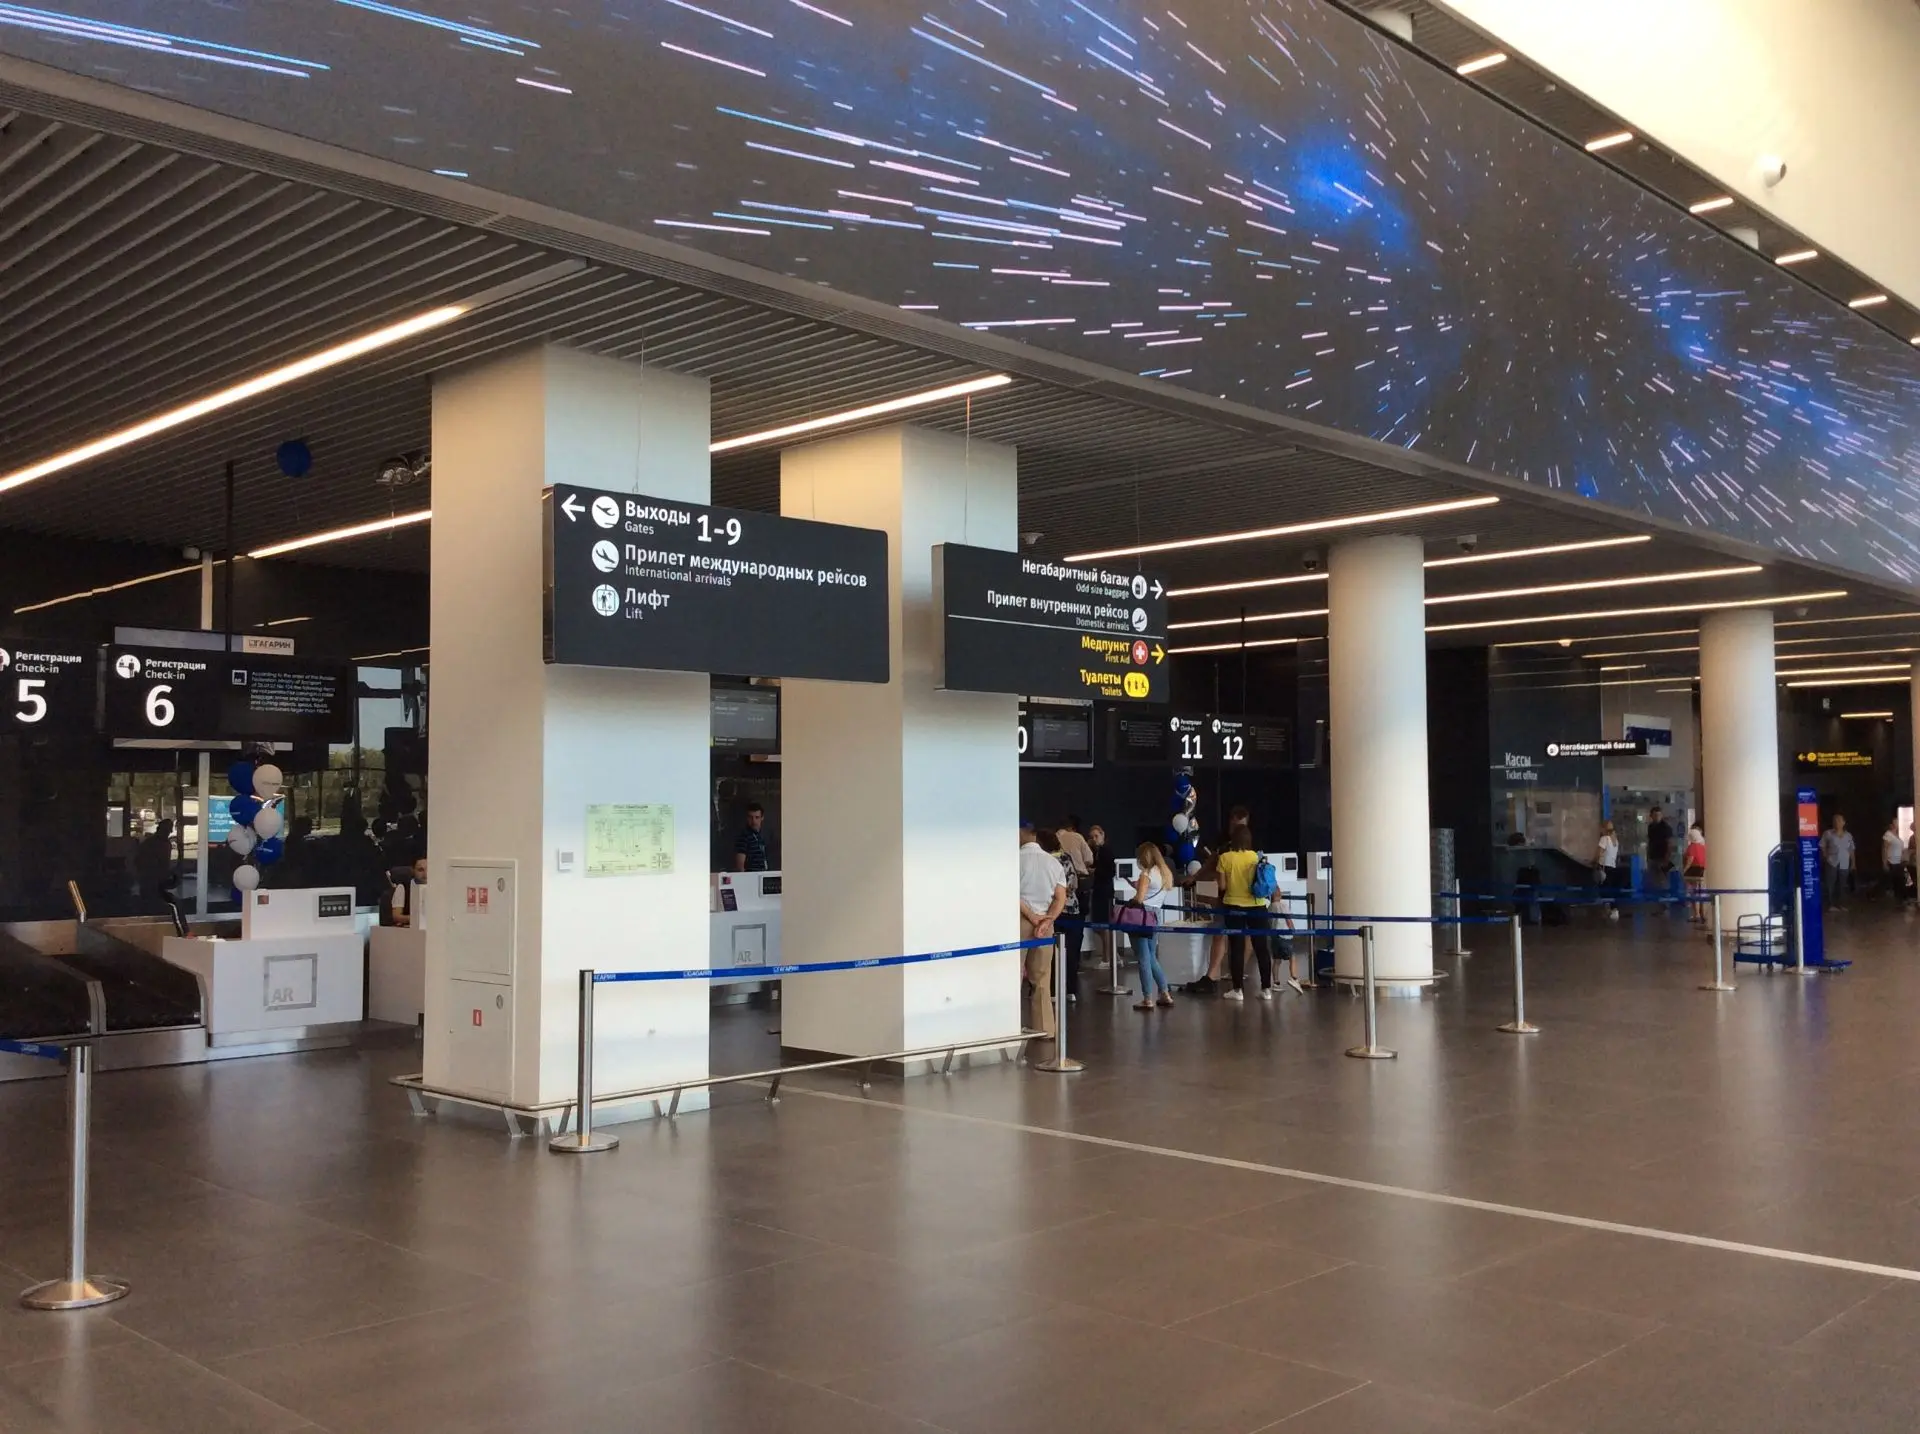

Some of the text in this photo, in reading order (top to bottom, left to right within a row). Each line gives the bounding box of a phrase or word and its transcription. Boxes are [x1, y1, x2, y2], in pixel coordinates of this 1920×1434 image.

[625, 500, 690, 525] Выходы
[625, 520, 654, 535] Gates
[697, 514, 742, 545] 1-9
[625, 544, 867, 588] Прилет международных рейсов
[1022, 559, 1130, 586] Негабаритный багаж
[625, 566, 732, 587] International arrivals
[625, 587, 670, 610] Лифт
[987, 590, 1129, 621] Прилет внутренних рейсов
[625, 608, 644, 620] Lift
[1076, 617, 1129, 631] Domestic arrivals
[1082, 635, 1130, 653] Медпункт
[16, 651, 82, 664] Регистрация
[145, 659, 206, 671] Регистрация
[15, 663, 59, 673] Check-in
[145, 670, 186, 680] Check-in
[1080, 669, 1121, 686] Туалеты
[16, 679, 47, 722] 5
[1101, 687, 1122, 697] Toilets
[146, 685, 174, 726] 6
[1181, 734, 1203, 759] 11
[1223, 736, 1243, 760] 12
[1505, 752, 1531, 767] Кассы
[1506, 770, 1538, 781] Ticket office
